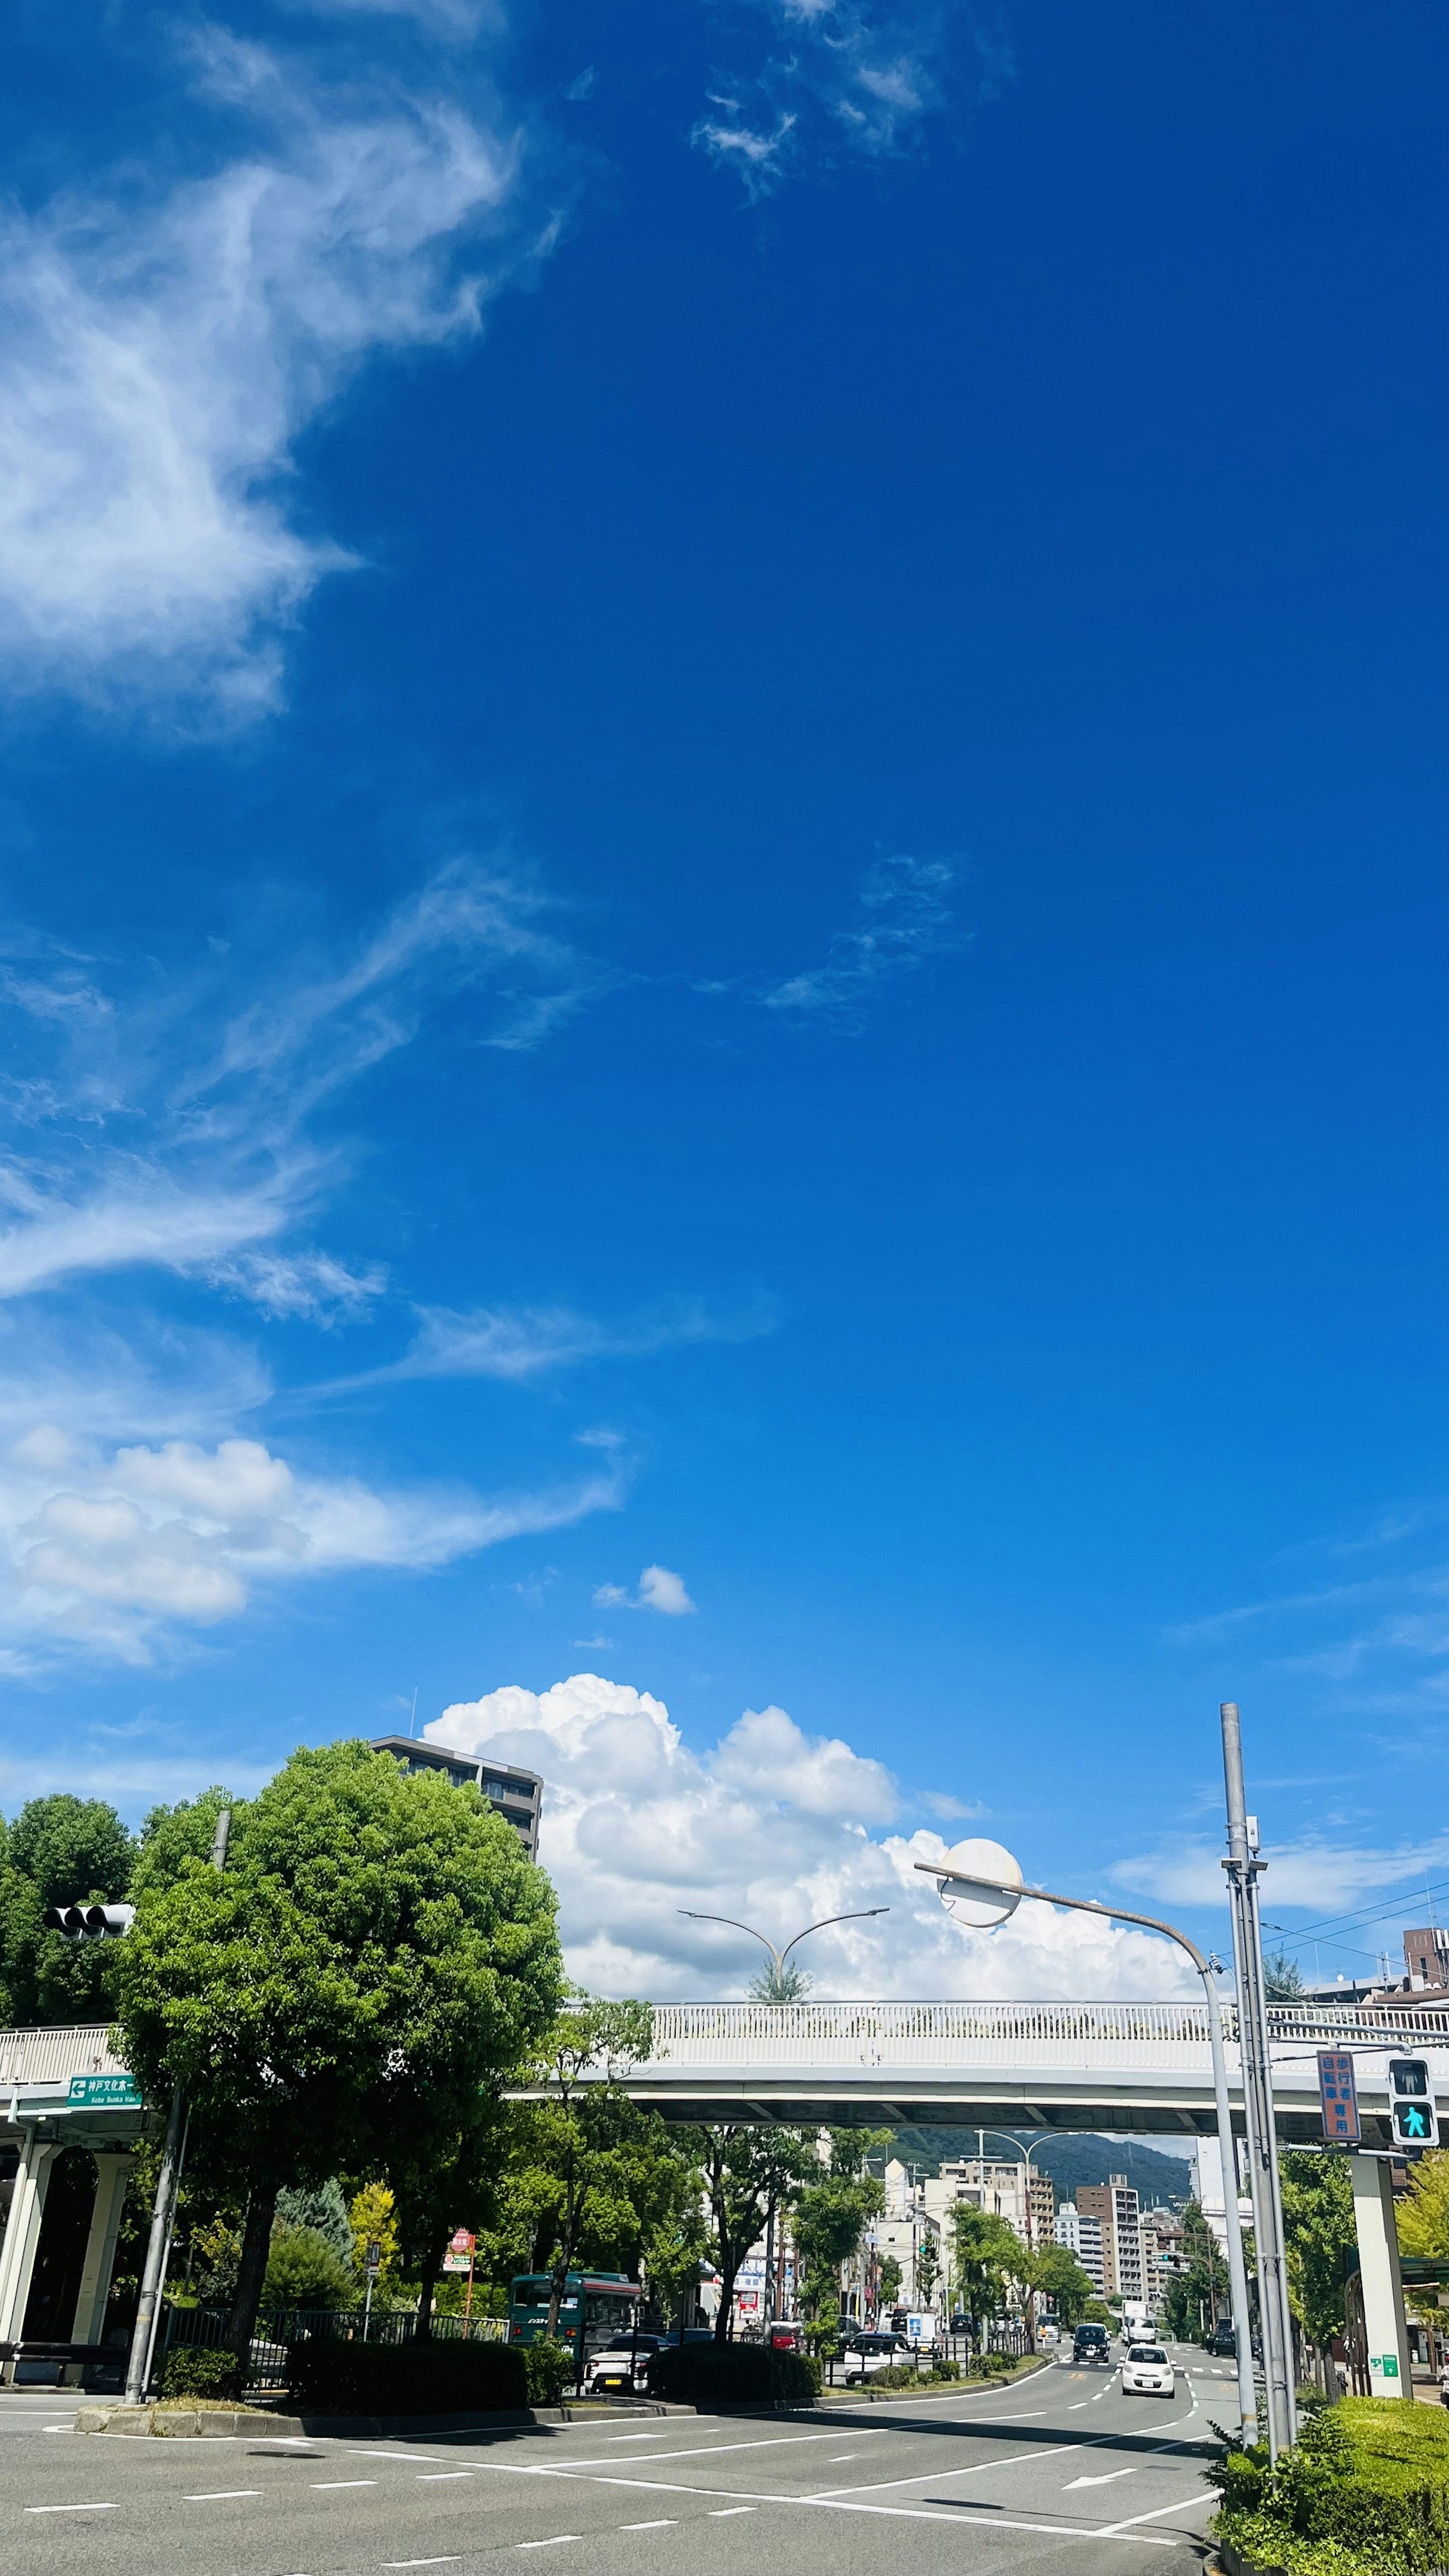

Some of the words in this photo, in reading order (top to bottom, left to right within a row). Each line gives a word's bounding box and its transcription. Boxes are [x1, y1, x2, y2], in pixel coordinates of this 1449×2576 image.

[88, 2079, 134, 2092] 神戸文化ホー
[1323, 2057, 1337, 2098] 自転車
[1337, 2058, 1351, 2099] 歩行者
[1335, 2104, 1347, 2132] 専用
